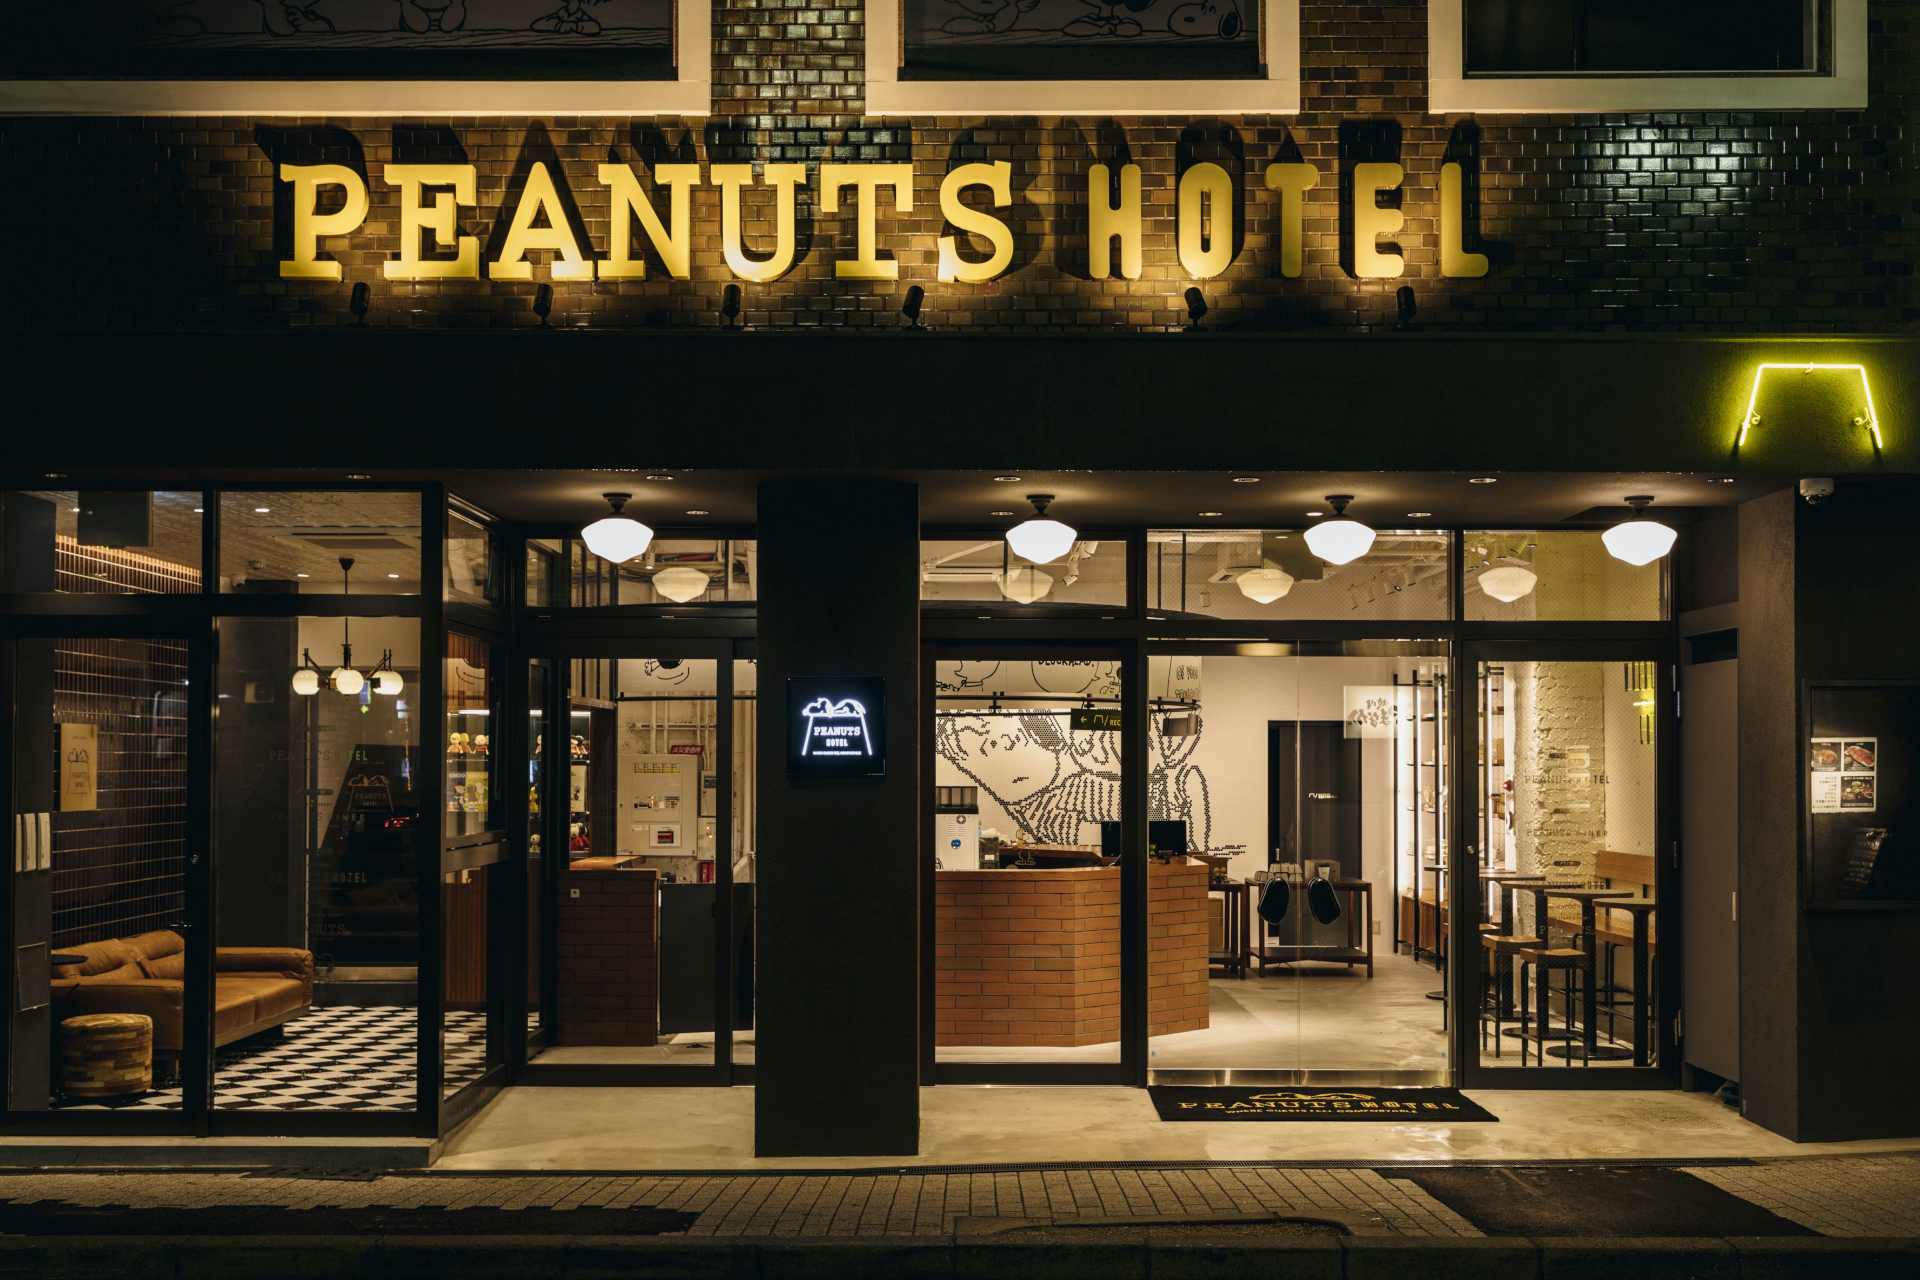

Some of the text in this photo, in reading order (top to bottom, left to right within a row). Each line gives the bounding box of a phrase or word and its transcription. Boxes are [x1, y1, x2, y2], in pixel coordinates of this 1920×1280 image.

[280, 161, 1489, 283] PEANUTS HOTEL
[813, 726, 861, 736] PEANUTS
[825, 738, 849, 747] HOTEL
[268, 750, 330, 761] PEATS
[332, 872, 367, 883] HOTEL
[1178, 1101, 1460, 1109] PEANUTS HOTEL
